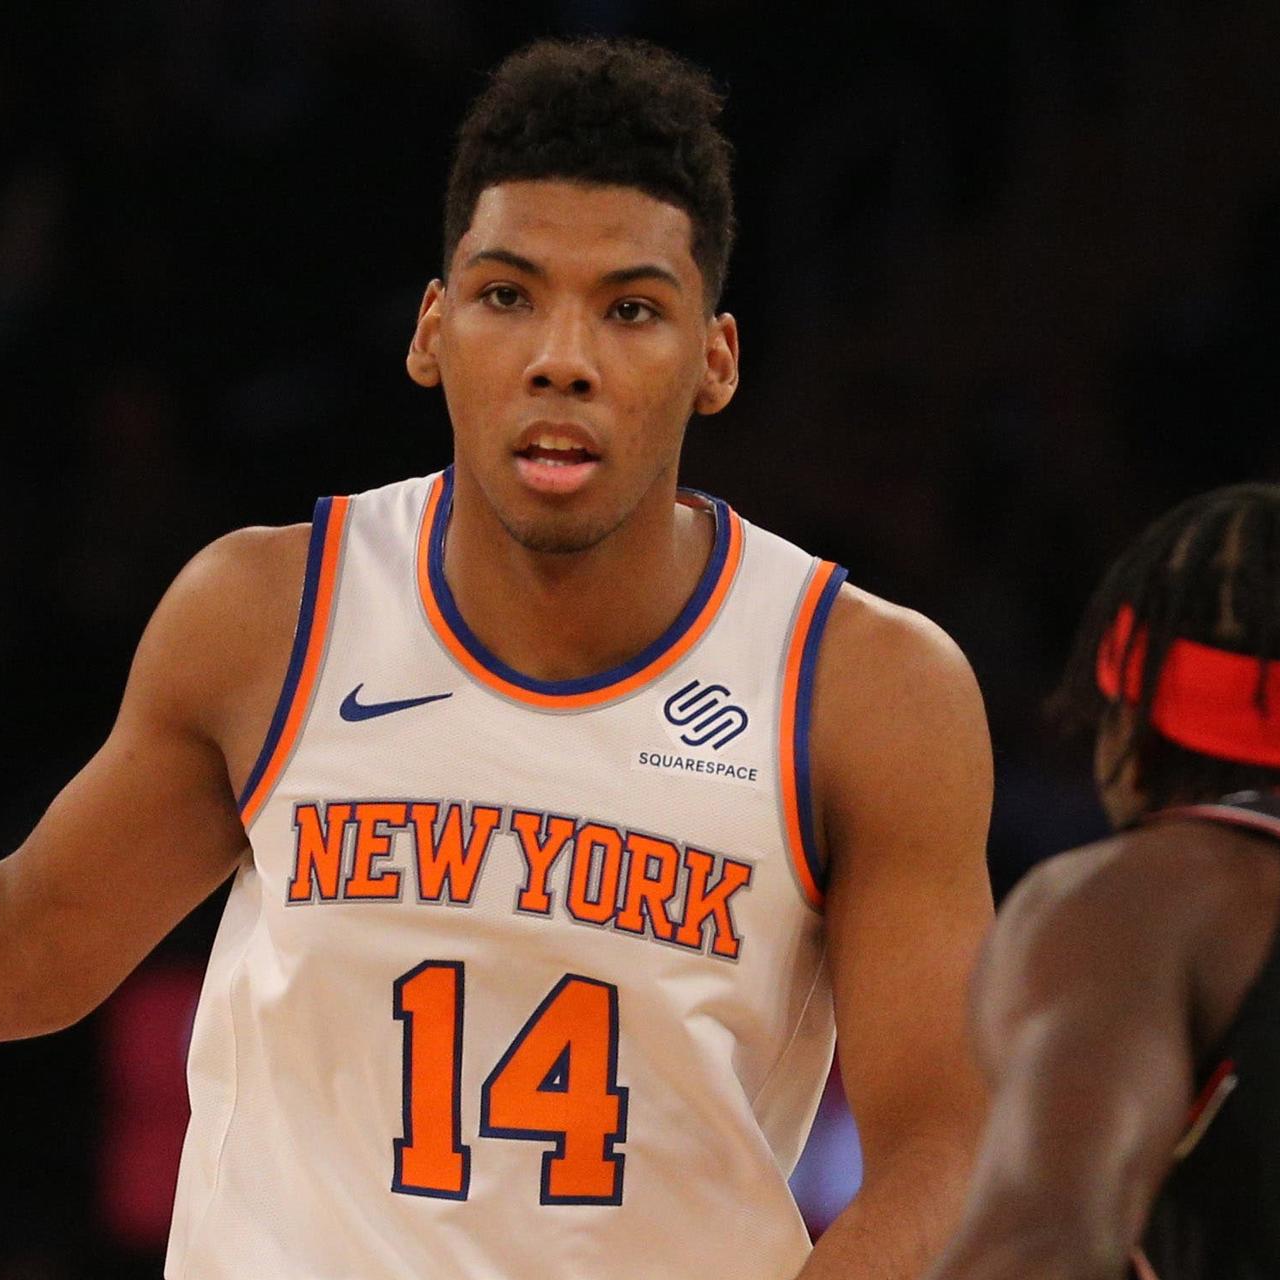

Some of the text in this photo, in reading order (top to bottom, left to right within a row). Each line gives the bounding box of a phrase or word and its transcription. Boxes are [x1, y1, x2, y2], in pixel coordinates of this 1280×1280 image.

[638, 751, 759, 782] SQUARESPACE
[285, 799, 755, 963] NEW YORK
[391, 959, 630, 1207] 14
